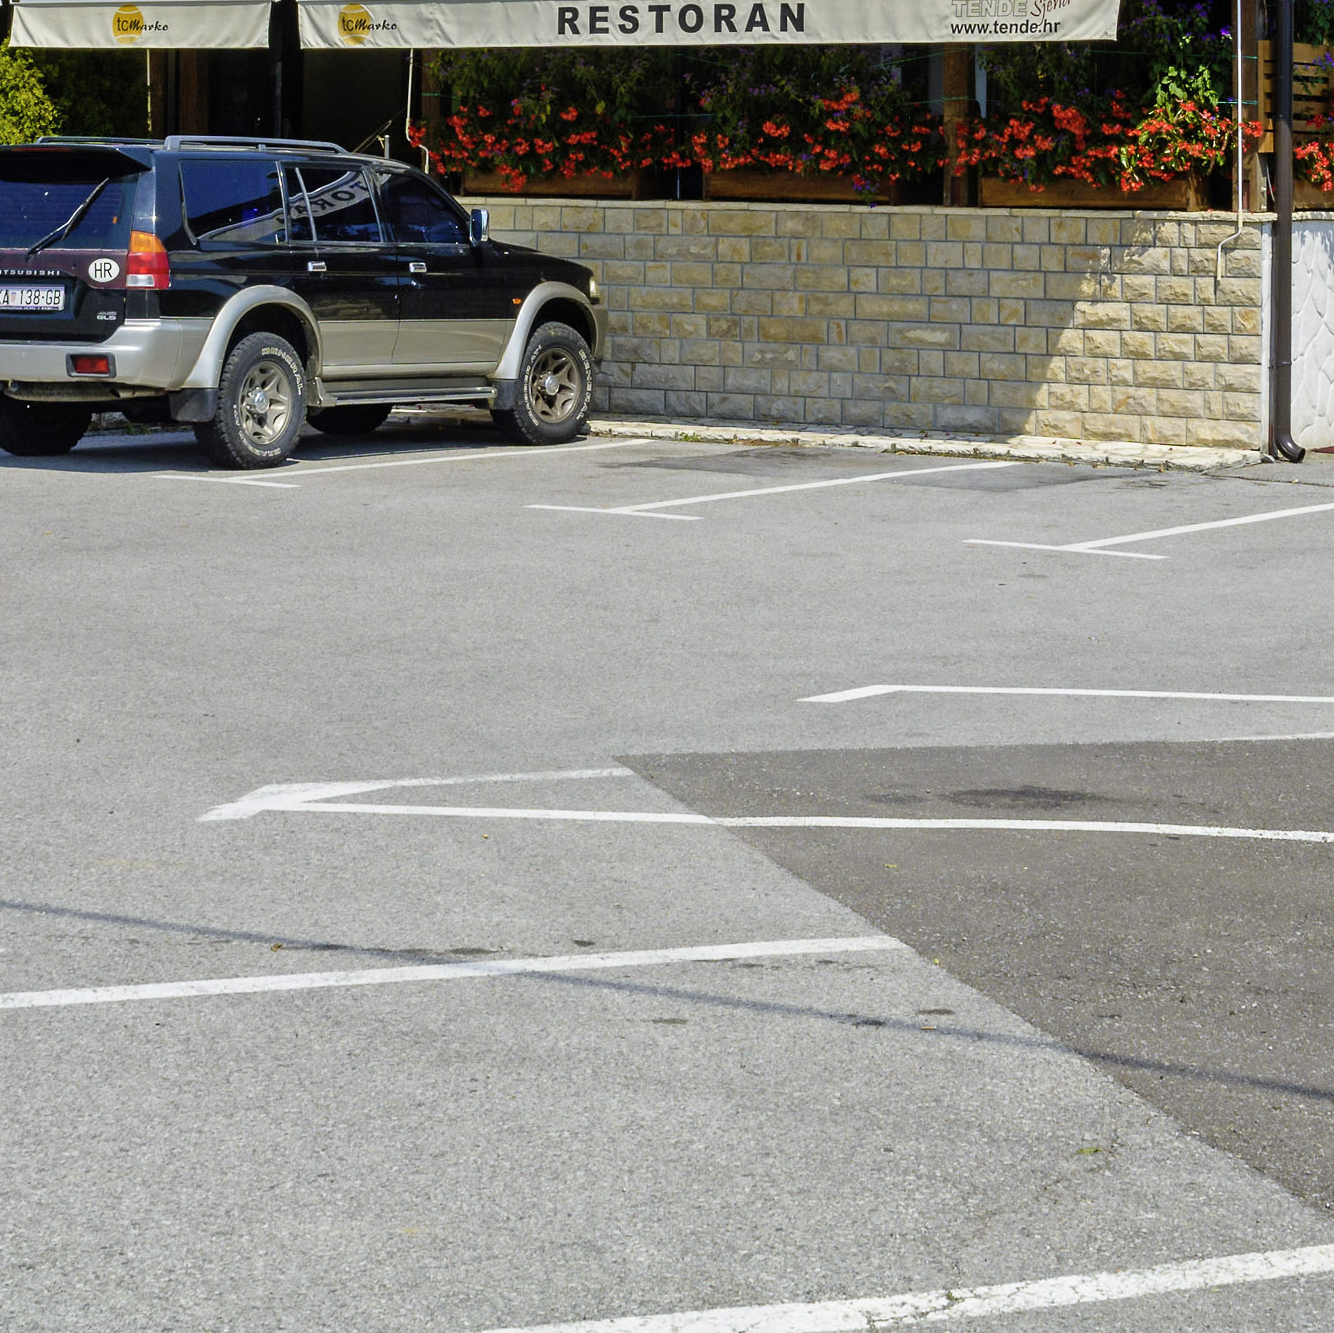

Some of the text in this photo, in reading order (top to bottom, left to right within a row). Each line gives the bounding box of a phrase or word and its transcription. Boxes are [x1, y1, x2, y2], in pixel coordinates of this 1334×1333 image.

[951, 0, 1028, 18] TENDE
[557, 2, 805, 35] RESTORAN
[950, 18, 1061, 35] www.tende.hr
[94, 262, 112, 279] HR
[20, 289, 61, 305] 138-GB
